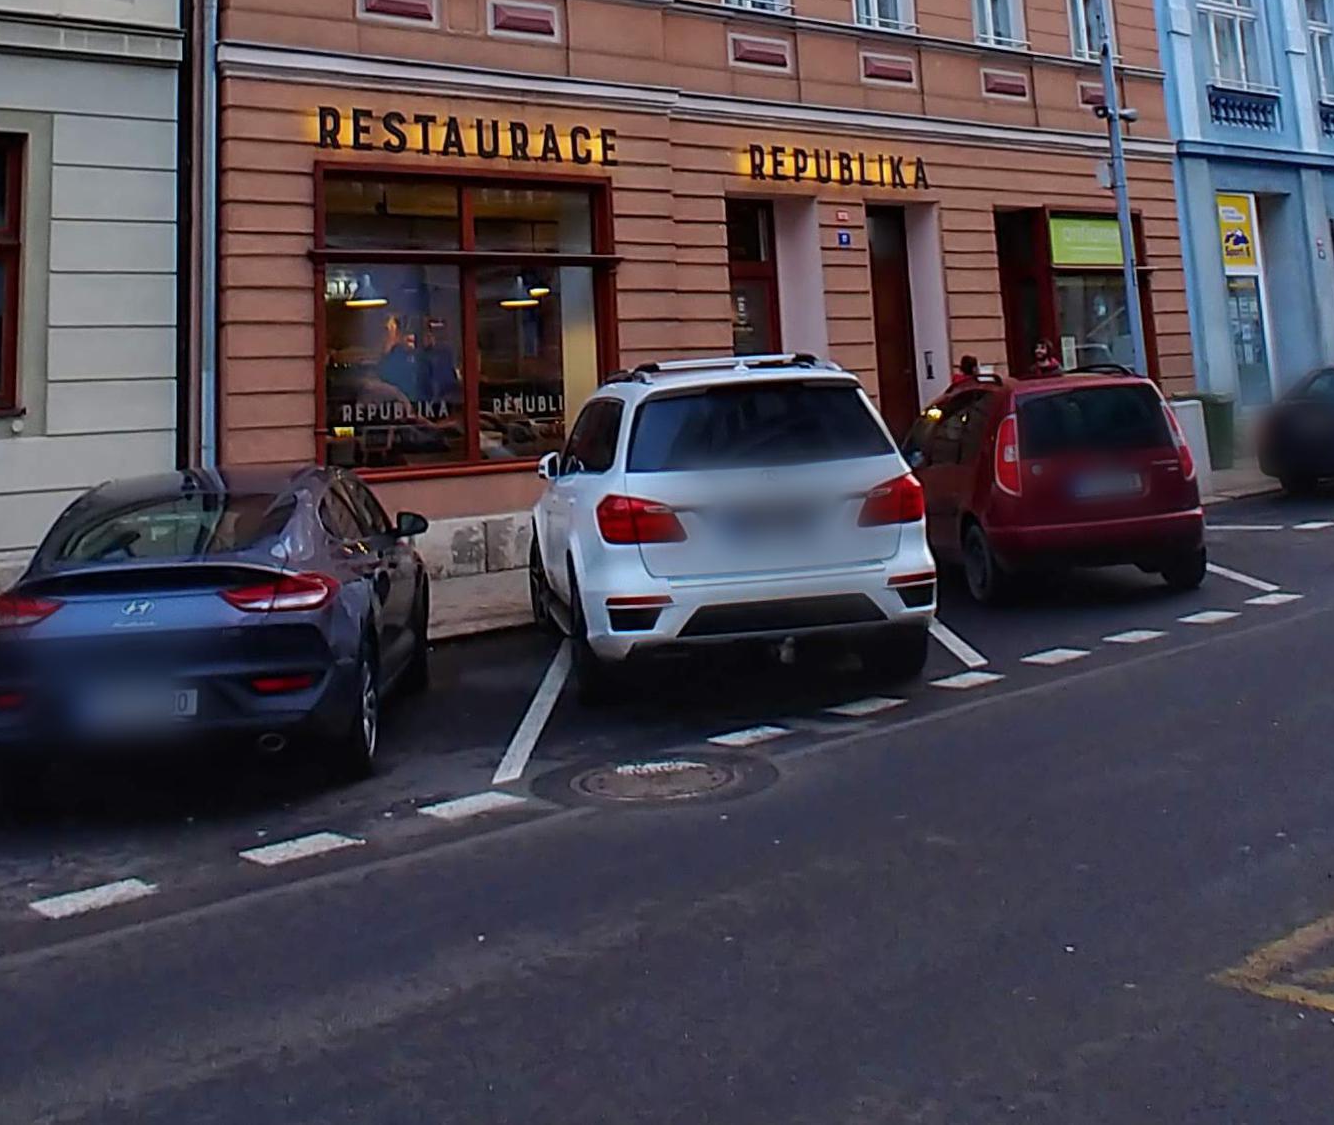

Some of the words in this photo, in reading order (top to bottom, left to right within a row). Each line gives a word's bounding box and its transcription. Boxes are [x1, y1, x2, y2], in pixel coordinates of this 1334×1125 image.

[317, 105, 619, 167] RESTAURACE
[749, 143, 929, 190] REPUBLIKA
[342, 399, 450, 423] REPUBLIKA
